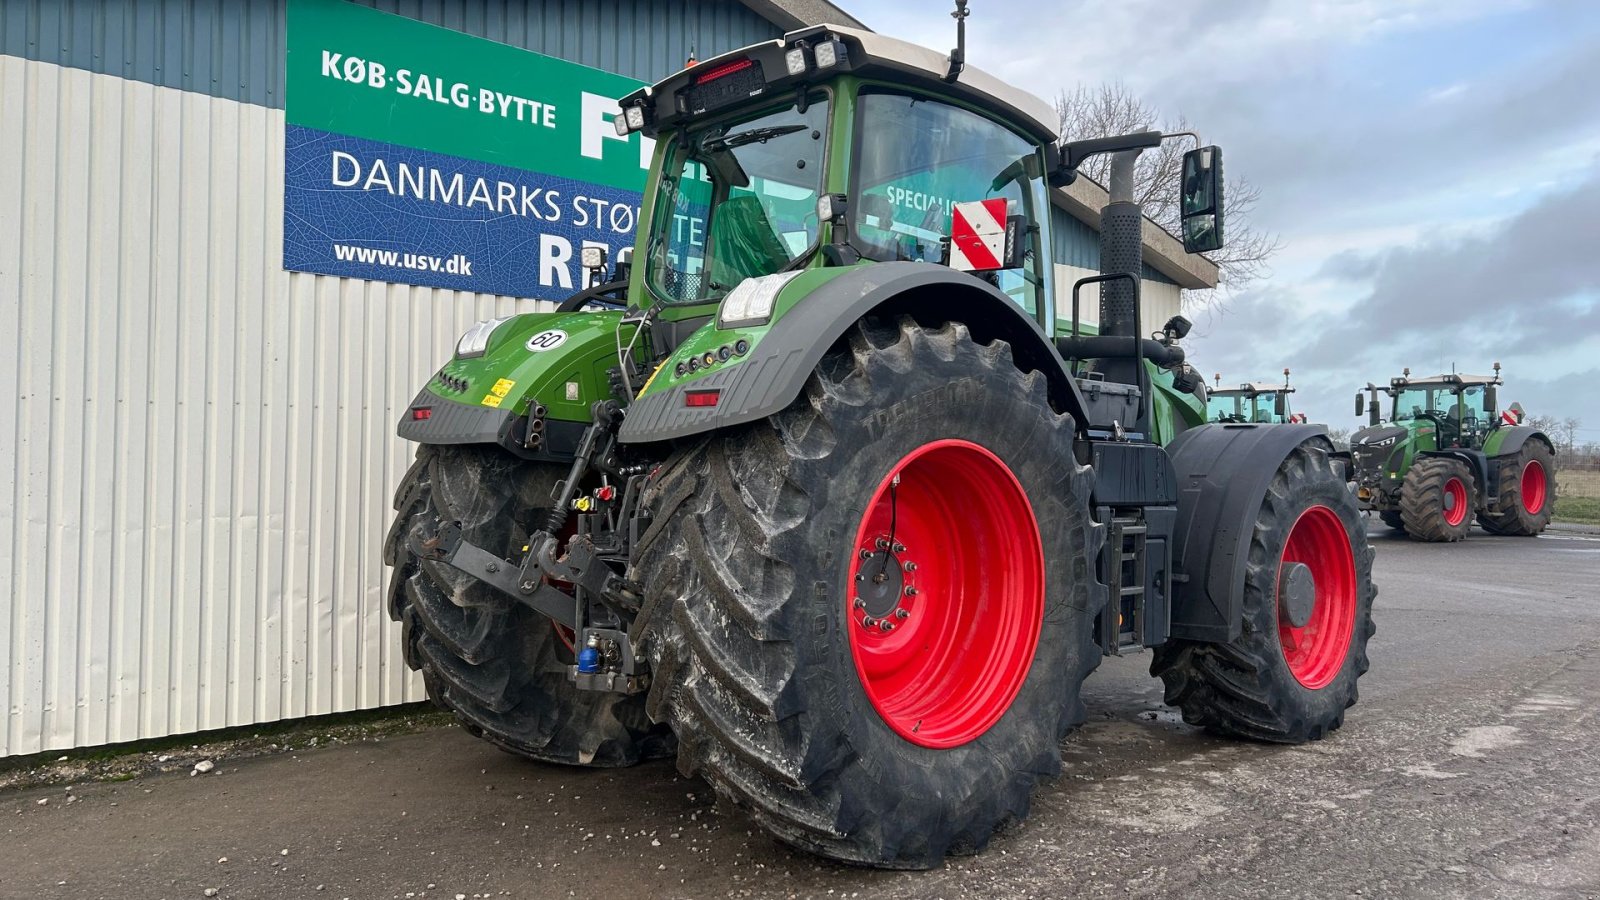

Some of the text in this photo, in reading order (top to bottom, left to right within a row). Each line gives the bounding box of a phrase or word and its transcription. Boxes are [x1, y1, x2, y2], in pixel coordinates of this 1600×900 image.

[332, 151, 561, 222] DANMARKS
[334, 245, 472, 276] www.usv.dk
[531, 332, 563, 348] 60
